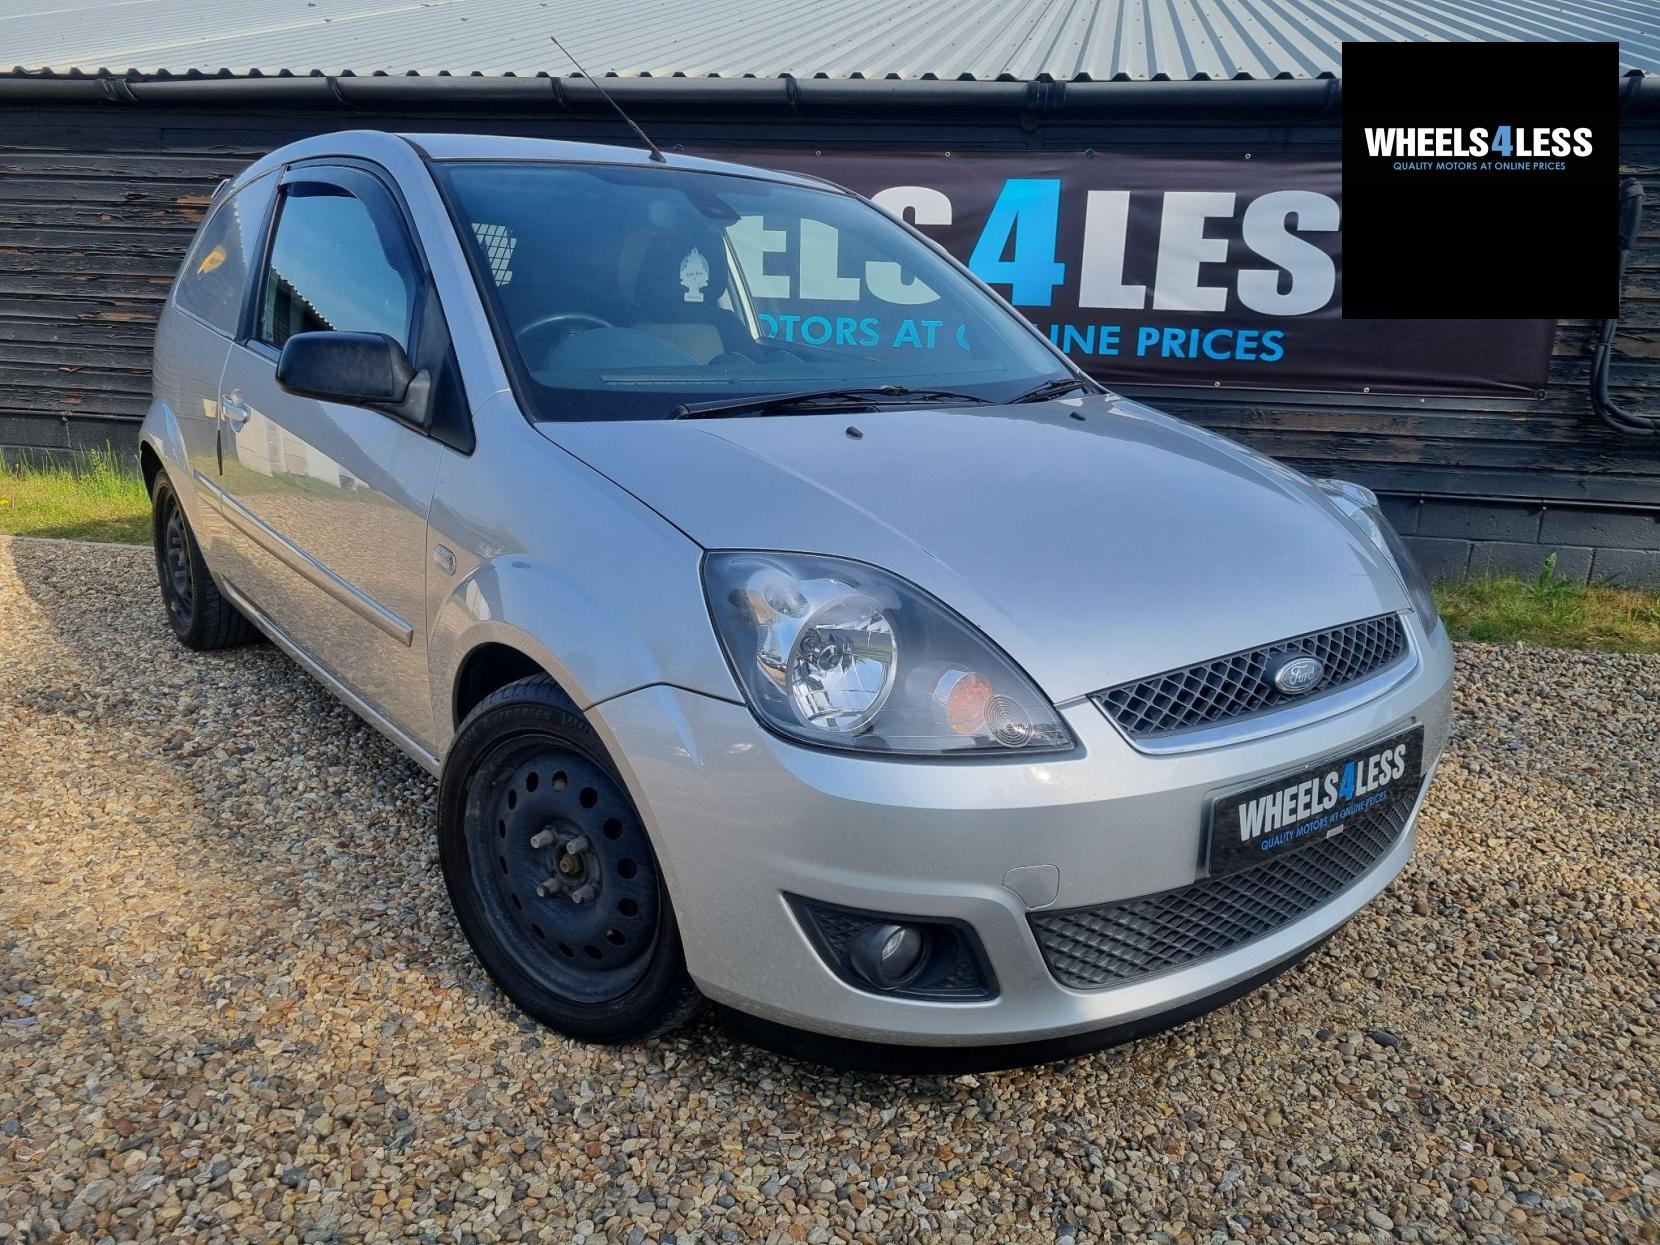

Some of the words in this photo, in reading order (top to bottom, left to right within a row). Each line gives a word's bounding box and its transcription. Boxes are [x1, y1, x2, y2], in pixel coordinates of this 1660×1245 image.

[892, 319, 944, 349] AT
[1136, 326, 1285, 362] PRICES
[1290, 664, 1316, 685] Ford
[1238, 744, 1406, 842] WHEELS4LESS
[1262, 829, 1294, 850] QUALITY
[1296, 815, 1327, 837] MOTORS
[1330, 811, 1339, 824] AT
[1340, 800, 1364, 818] ONLINE
